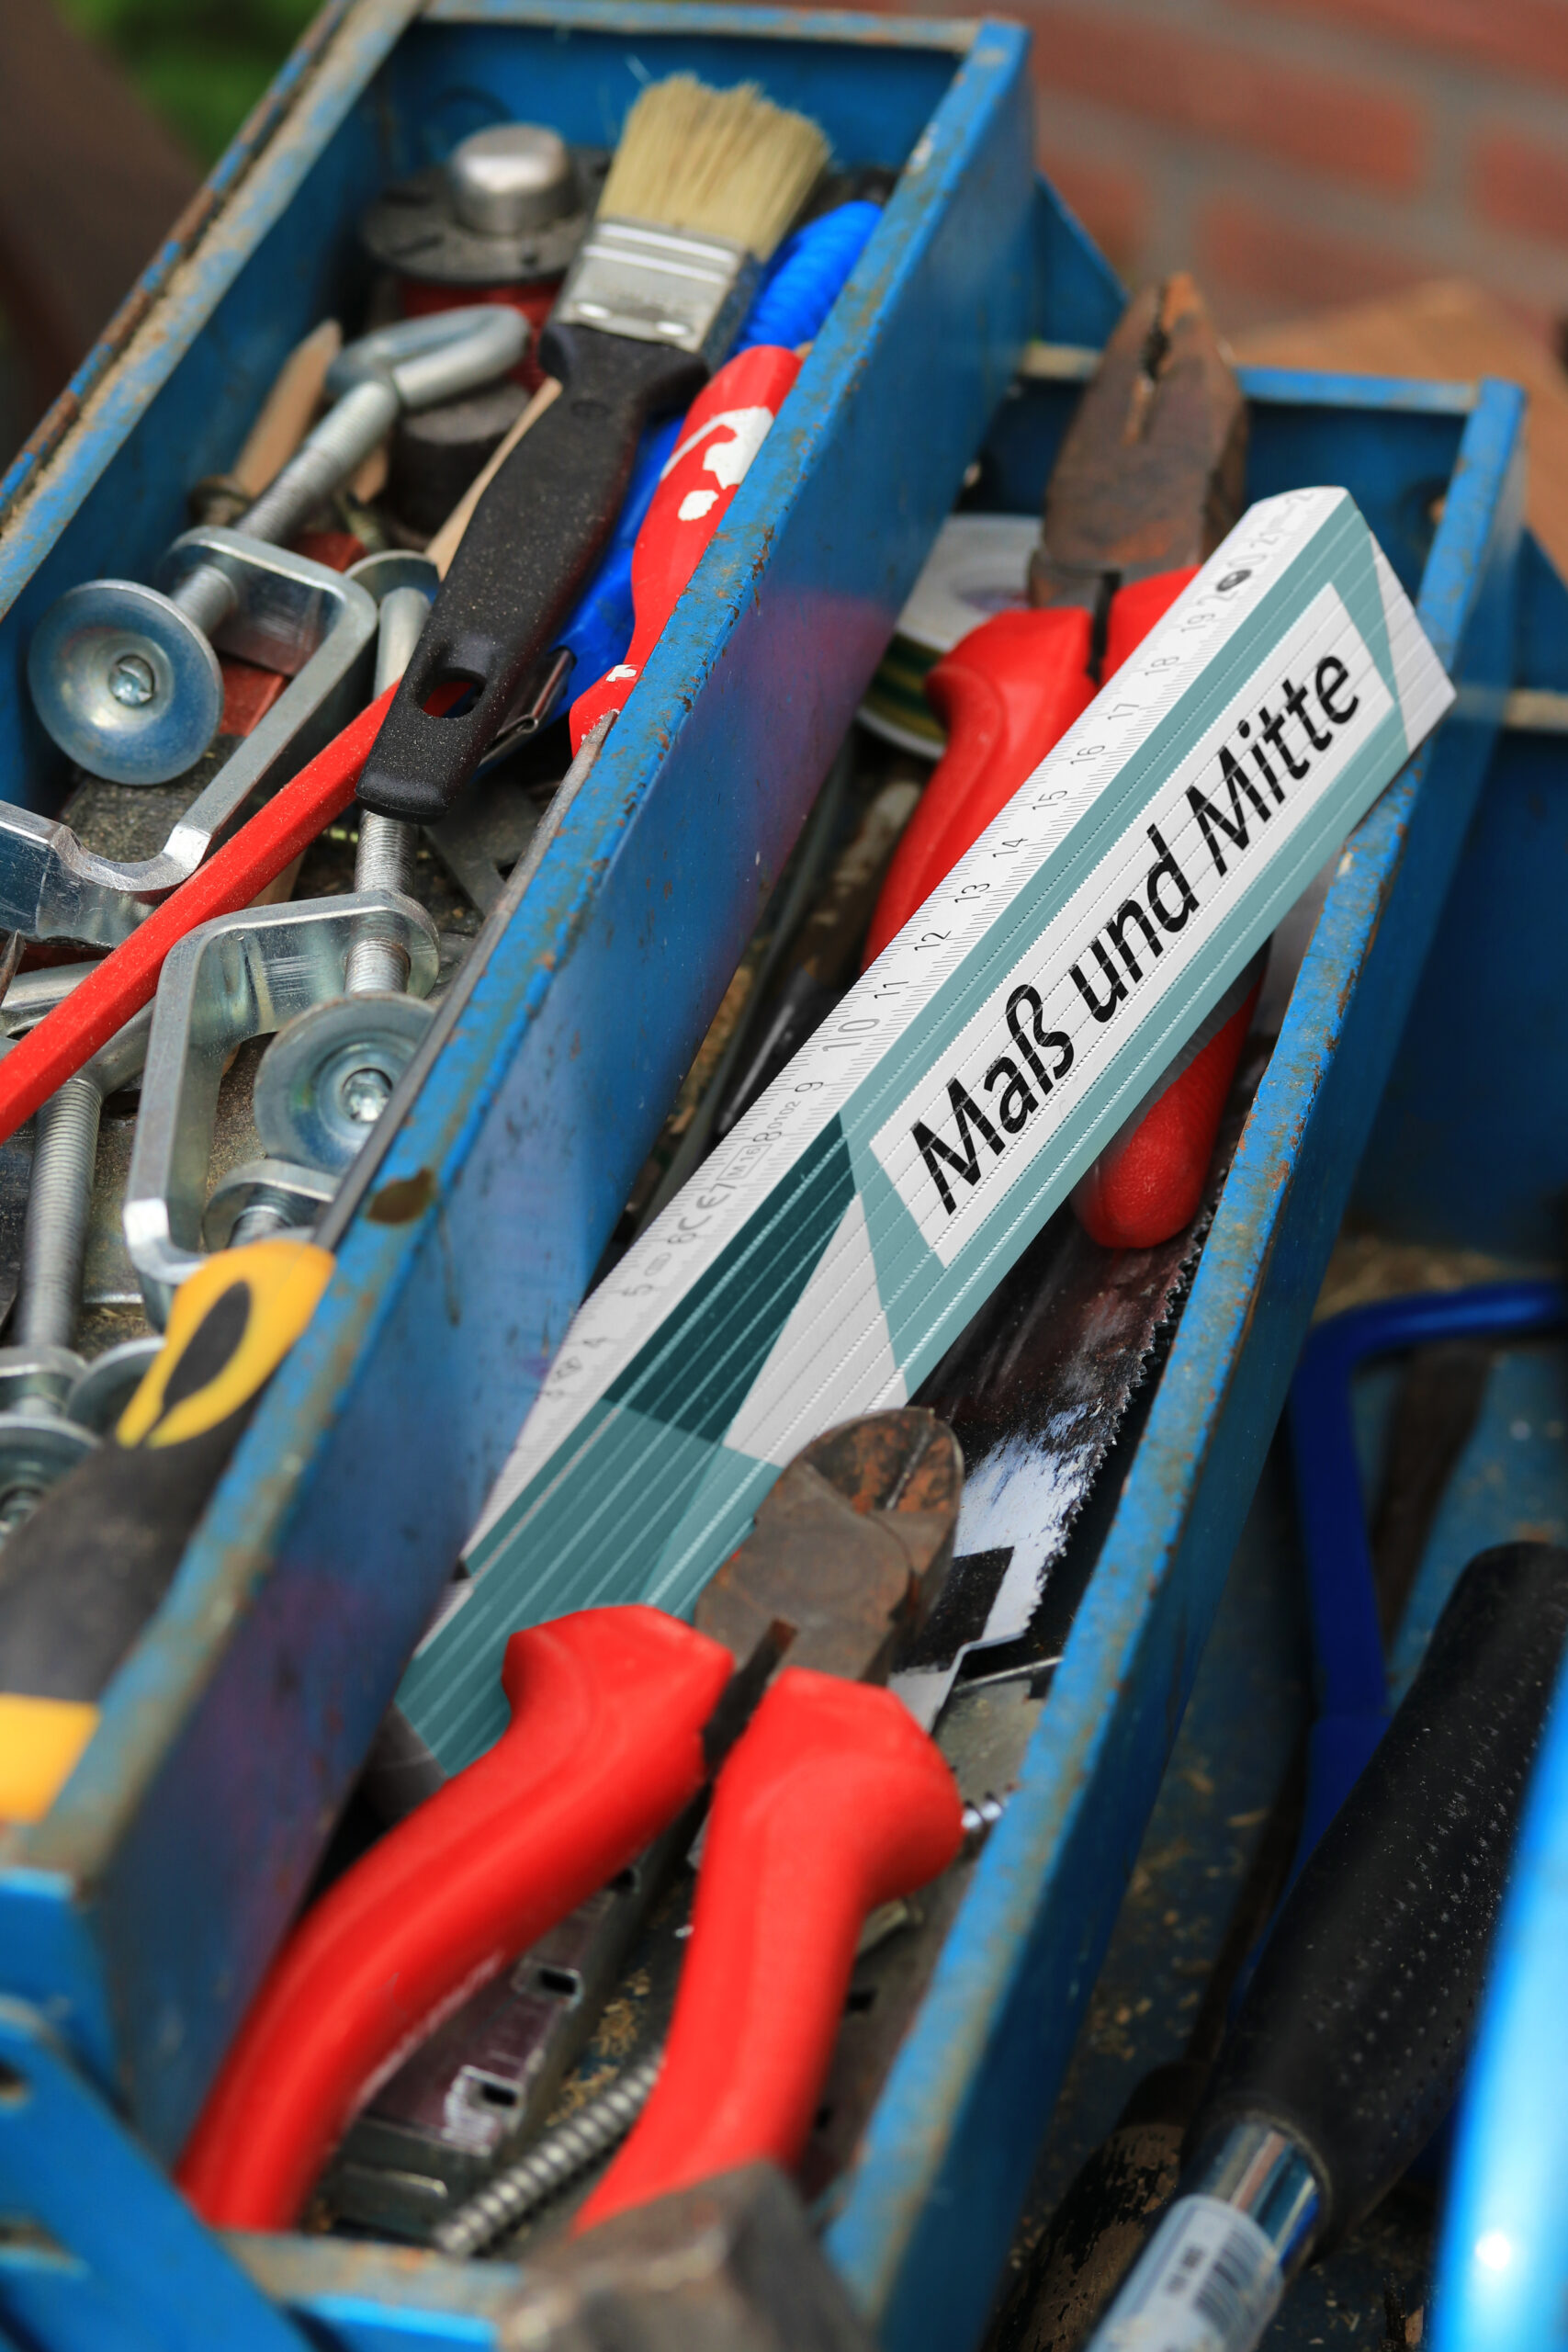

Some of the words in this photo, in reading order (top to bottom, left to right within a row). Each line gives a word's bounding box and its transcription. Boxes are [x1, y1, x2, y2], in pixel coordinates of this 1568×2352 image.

[622, 1283, 654, 1298] 5
[667, 1230, 697, 1245] 6
[708, 1182, 738, 1193] 7
[752, 1130, 783, 1143] 8
[795, 1081, 824, 1092] 9
[822, 1018, 881, 1052] 10
[874, 980, 909, 999] 11
[914, 930, 952, 952] 12
[953, 883, 990, 903] 13
[992, 837, 1028, 858] 14
[1032, 790, 1068, 810] 15
[1069, 745, 1106, 765] 16
[1107, 703, 1140, 721] 17
[1144, 656, 1180, 677] 18
[1180, 612, 1217, 633] 19
[766, 1100, 802, 1130] 0102
[909, 984, 1075, 1216] Maß
[1068, 823, 1200, 1023] und
[1185, 655, 1360, 877] Mitte
